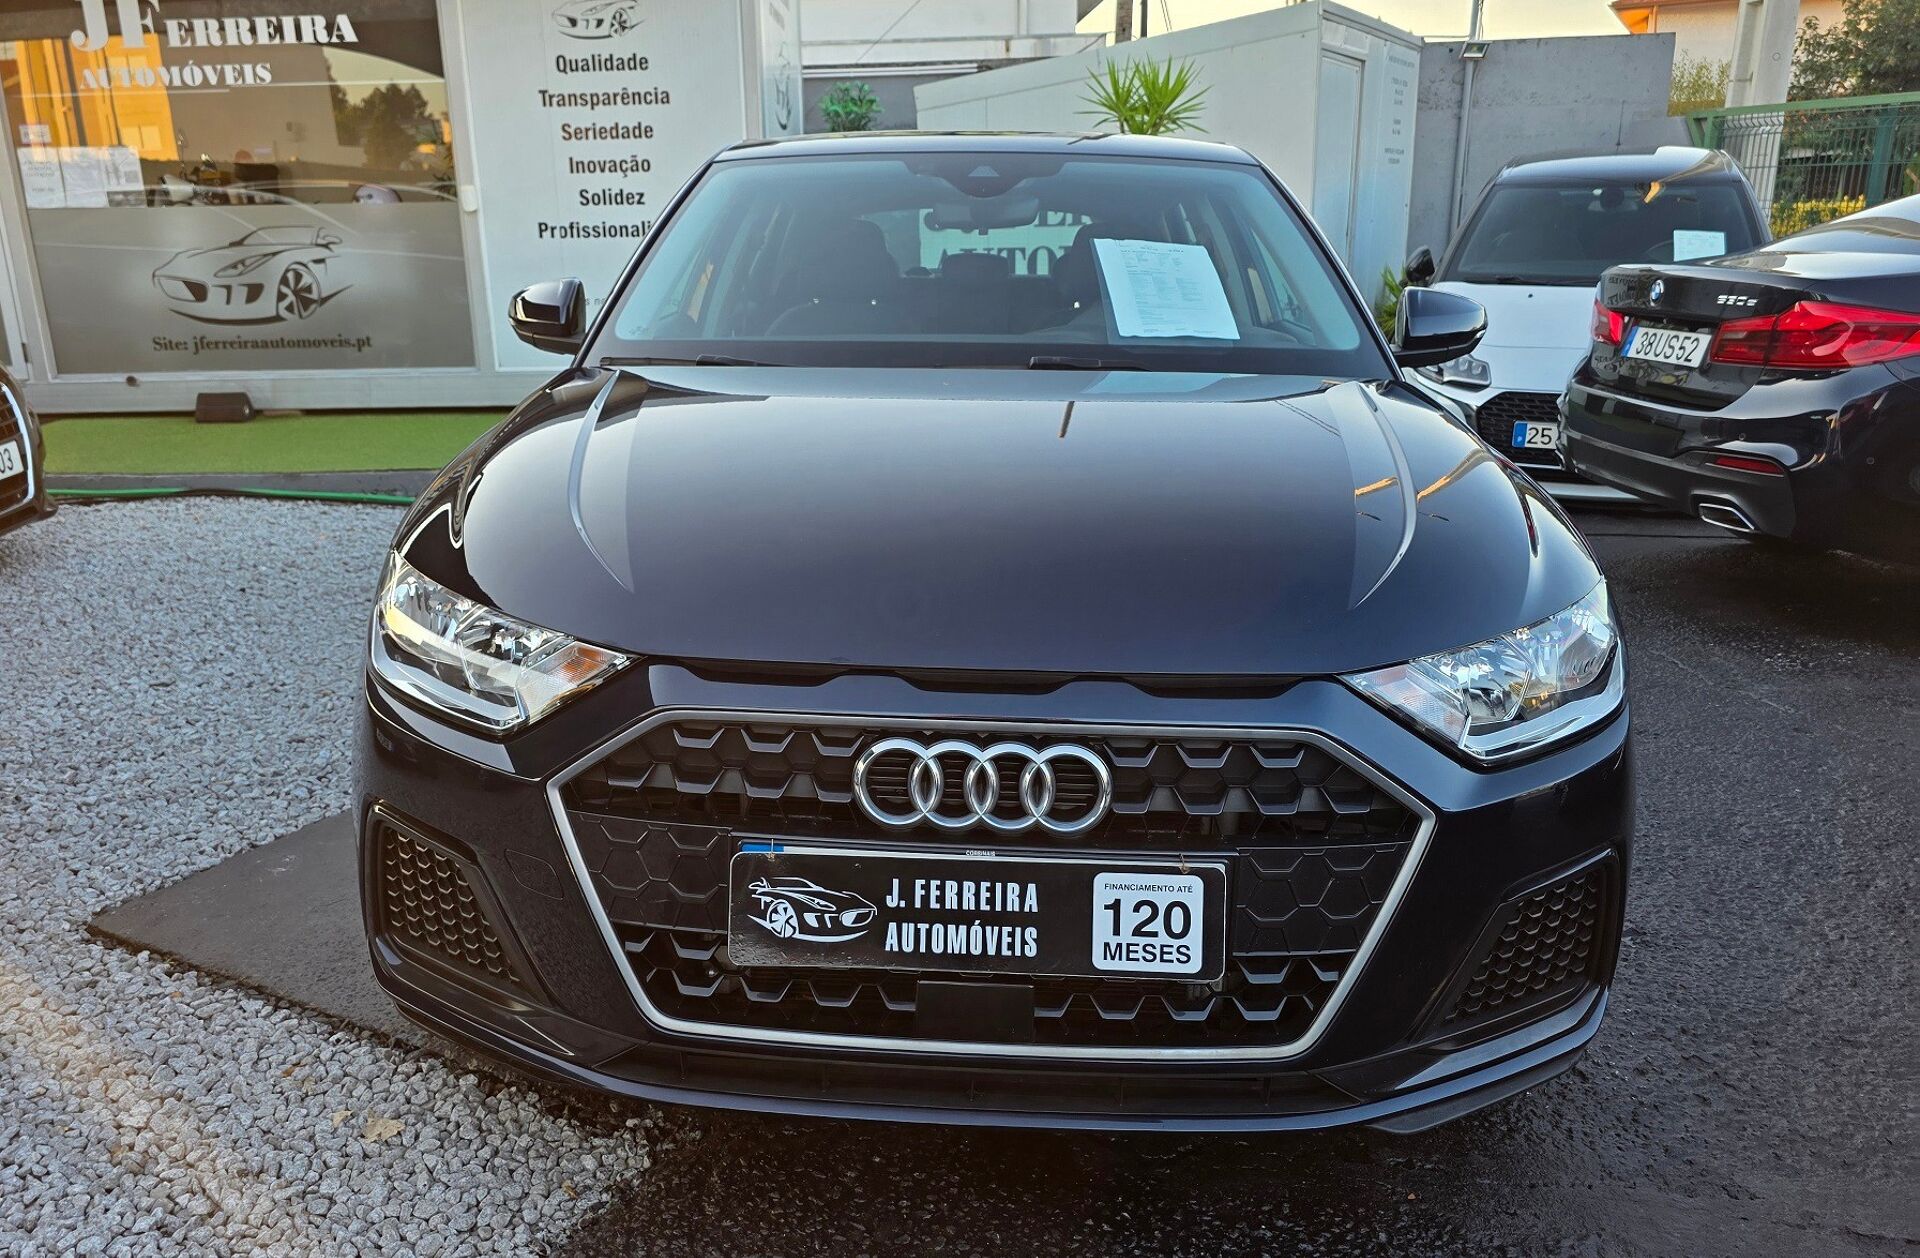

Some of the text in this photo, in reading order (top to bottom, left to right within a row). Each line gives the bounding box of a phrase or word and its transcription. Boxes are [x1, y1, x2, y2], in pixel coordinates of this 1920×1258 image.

[80, 60, 273, 90] AUTOMÓVEIS
[555, 53, 649, 75] Qualidade
[538, 87, 671, 110] Transparência
[560, 122, 654, 142] Seriedade
[568, 155, 651, 178] Inovação
[579, 188, 645, 206] Solidez
[152, 333, 372, 355] Site: jferreiraautomoveis.pt
[1636, 331, 1700, 363] 38US52
[1526, 427, 1553, 446] 25
[886, 878, 1039, 913] J. FERREIRA
[1104, 883, 1193, 893] FINANCIAMENTO ATÉ
[1103, 898, 1192, 940] 120
[885, 919, 1038, 957] AUTOMÓVEIS
[1103, 942, 1192, 964] MESES
